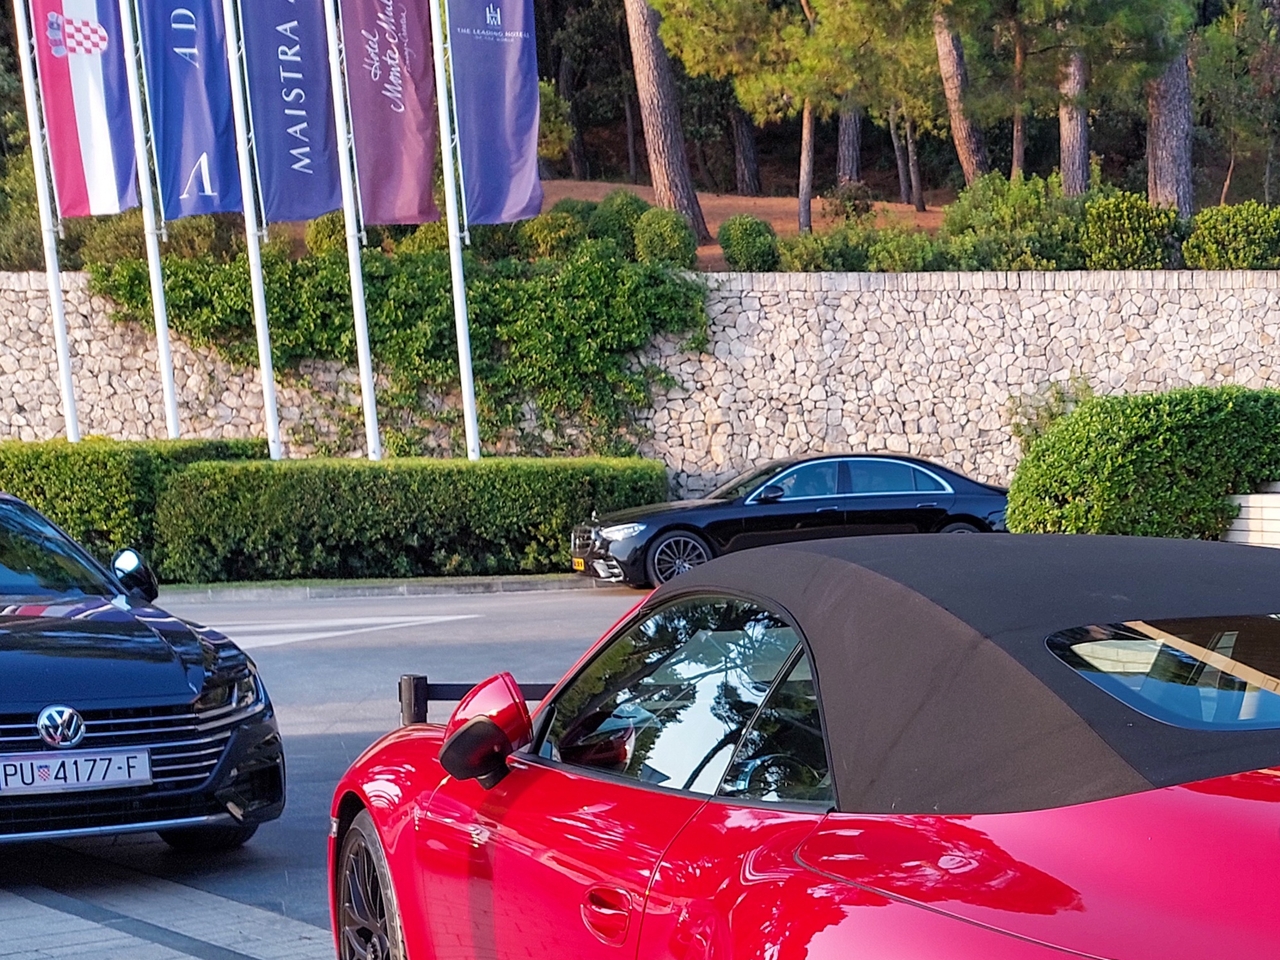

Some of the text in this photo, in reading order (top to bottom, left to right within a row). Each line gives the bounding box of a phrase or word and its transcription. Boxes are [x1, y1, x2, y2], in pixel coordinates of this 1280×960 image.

[361, 29, 382, 81] Hotel
[473, 28, 503, 37] LEADING
[275, 20, 313, 174] MAISTRA
[382, 43, 405, 113] Monte
[2, 761, 36, 787] PU
